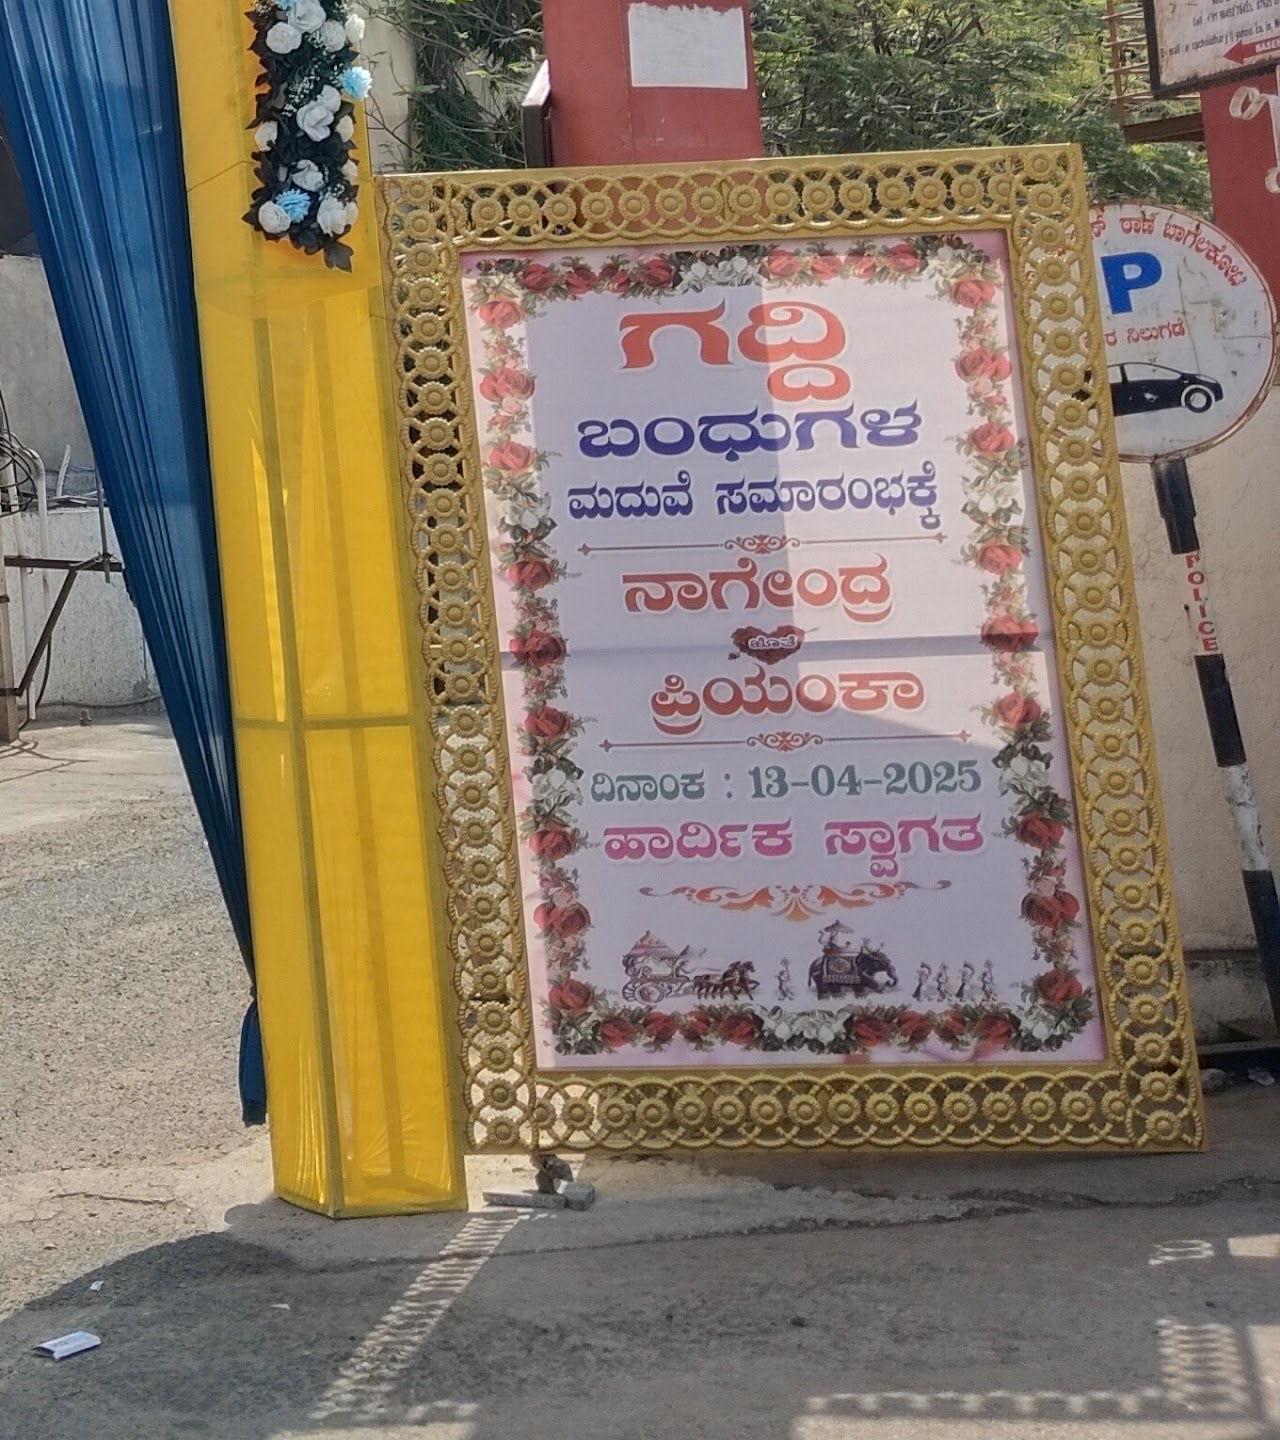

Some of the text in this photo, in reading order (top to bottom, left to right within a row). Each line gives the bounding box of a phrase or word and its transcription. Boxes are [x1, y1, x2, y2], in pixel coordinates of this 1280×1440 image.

[1255, 39, 1280, 53] BASE
[1100, 252, 1162, 315] P
[618, 299, 851, 403] ಗದ್ದಿ
[577, 399, 923, 462] ಬಂಧುಗಳ
[568, 460, 942, 531] ಮದುವೆ ಸಮಾರಂಭಕ್ಕೆ
[622, 552, 894, 624] ನಾಗೇಂದ್ರ
[651, 663, 925, 735] ಪ್ರಿಯಂಕಾ
[591, 768, 705, 802] ದಿನಾಂಕ
[749, 760, 982, 800] 13-04-2025
[603, 812, 983, 878] ಹಾರ್ದಿಕ ಸ್ವಾಗತ
